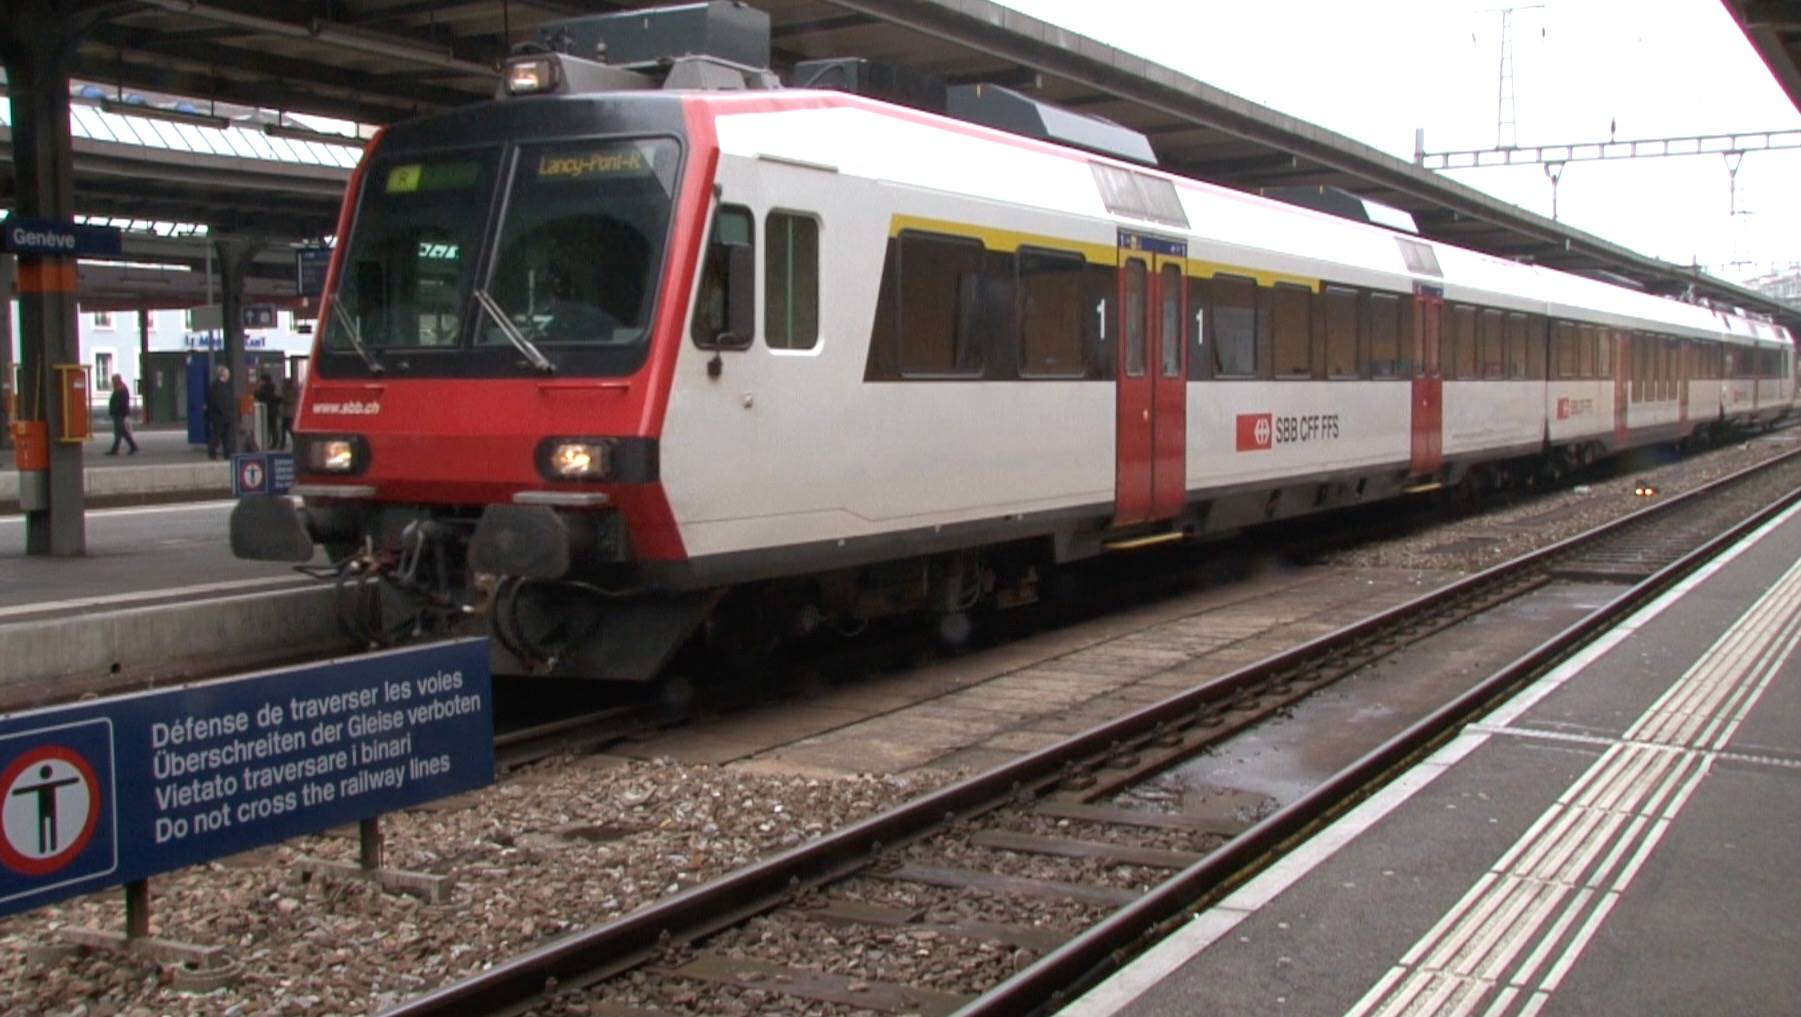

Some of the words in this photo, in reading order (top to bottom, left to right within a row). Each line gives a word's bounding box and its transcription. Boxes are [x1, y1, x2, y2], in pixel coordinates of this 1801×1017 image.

[13, 228, 76, 249] Genève
[1096, 298, 1105, 340] 1
[1196, 307, 1203, 345] 1
[312, 400, 380, 415] www.sbb.ch
[1276, 416, 1298, 443] SBB
[1300, 415, 1320, 442] CFF
[1321, 415, 1340, 440] FFS
[152, 711, 249, 748] Défense
[257, 702, 284, 728] de
[290, 687, 379, 721] traverser
[384, 680, 412, 703] les
[417, 670, 463, 696] voies
[153, 730, 306, 780] Überschreiten
[311, 722, 343, 746] der
[347, 709, 404, 738] Gleise
[408, 694, 481, 725] verboten
[155, 774, 238, 812] Vietato
[243, 751, 348, 791] traversare
[352, 745, 357, 767] i
[361, 733, 412, 764] binari
[155, 817, 188, 843] Do
[194, 802, 232, 834] not
[237, 791, 297, 822] cross
[302, 782, 335, 807] the
[340, 765, 406, 798] railway
[410, 754, 450, 780] lines
